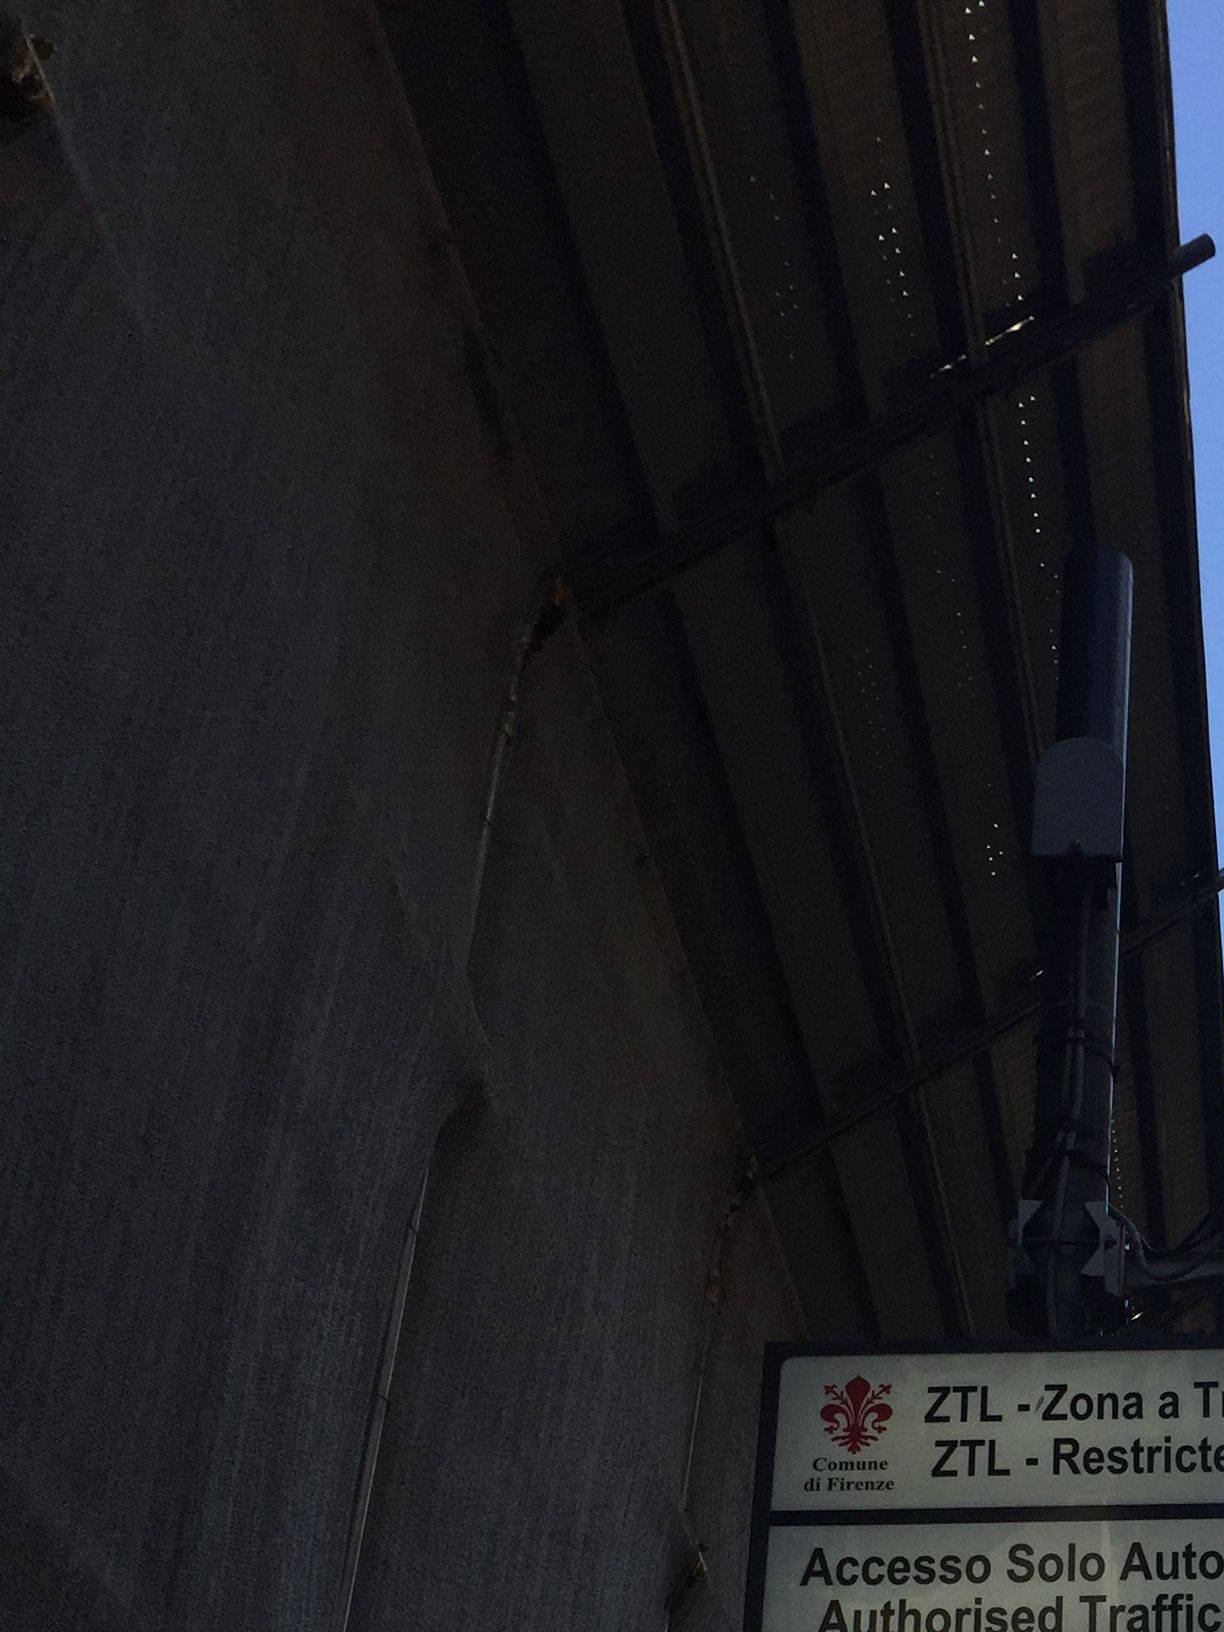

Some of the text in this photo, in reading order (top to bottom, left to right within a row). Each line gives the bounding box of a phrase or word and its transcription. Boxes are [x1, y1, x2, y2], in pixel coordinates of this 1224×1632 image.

[925, 1386, 1002, 1423] ZTL
[1041, 1384, 1144, 1421] Zona
[1158, 1389, 1180, 1419] a
[813, 1457, 888, 1472] Comune
[931, 1439, 1010, 1477] ZTL
[804, 1477, 894, 1492] di Firenze
[800, 1547, 991, 1586] Accesso
[1006, 1543, 1105, 1583] Solo
